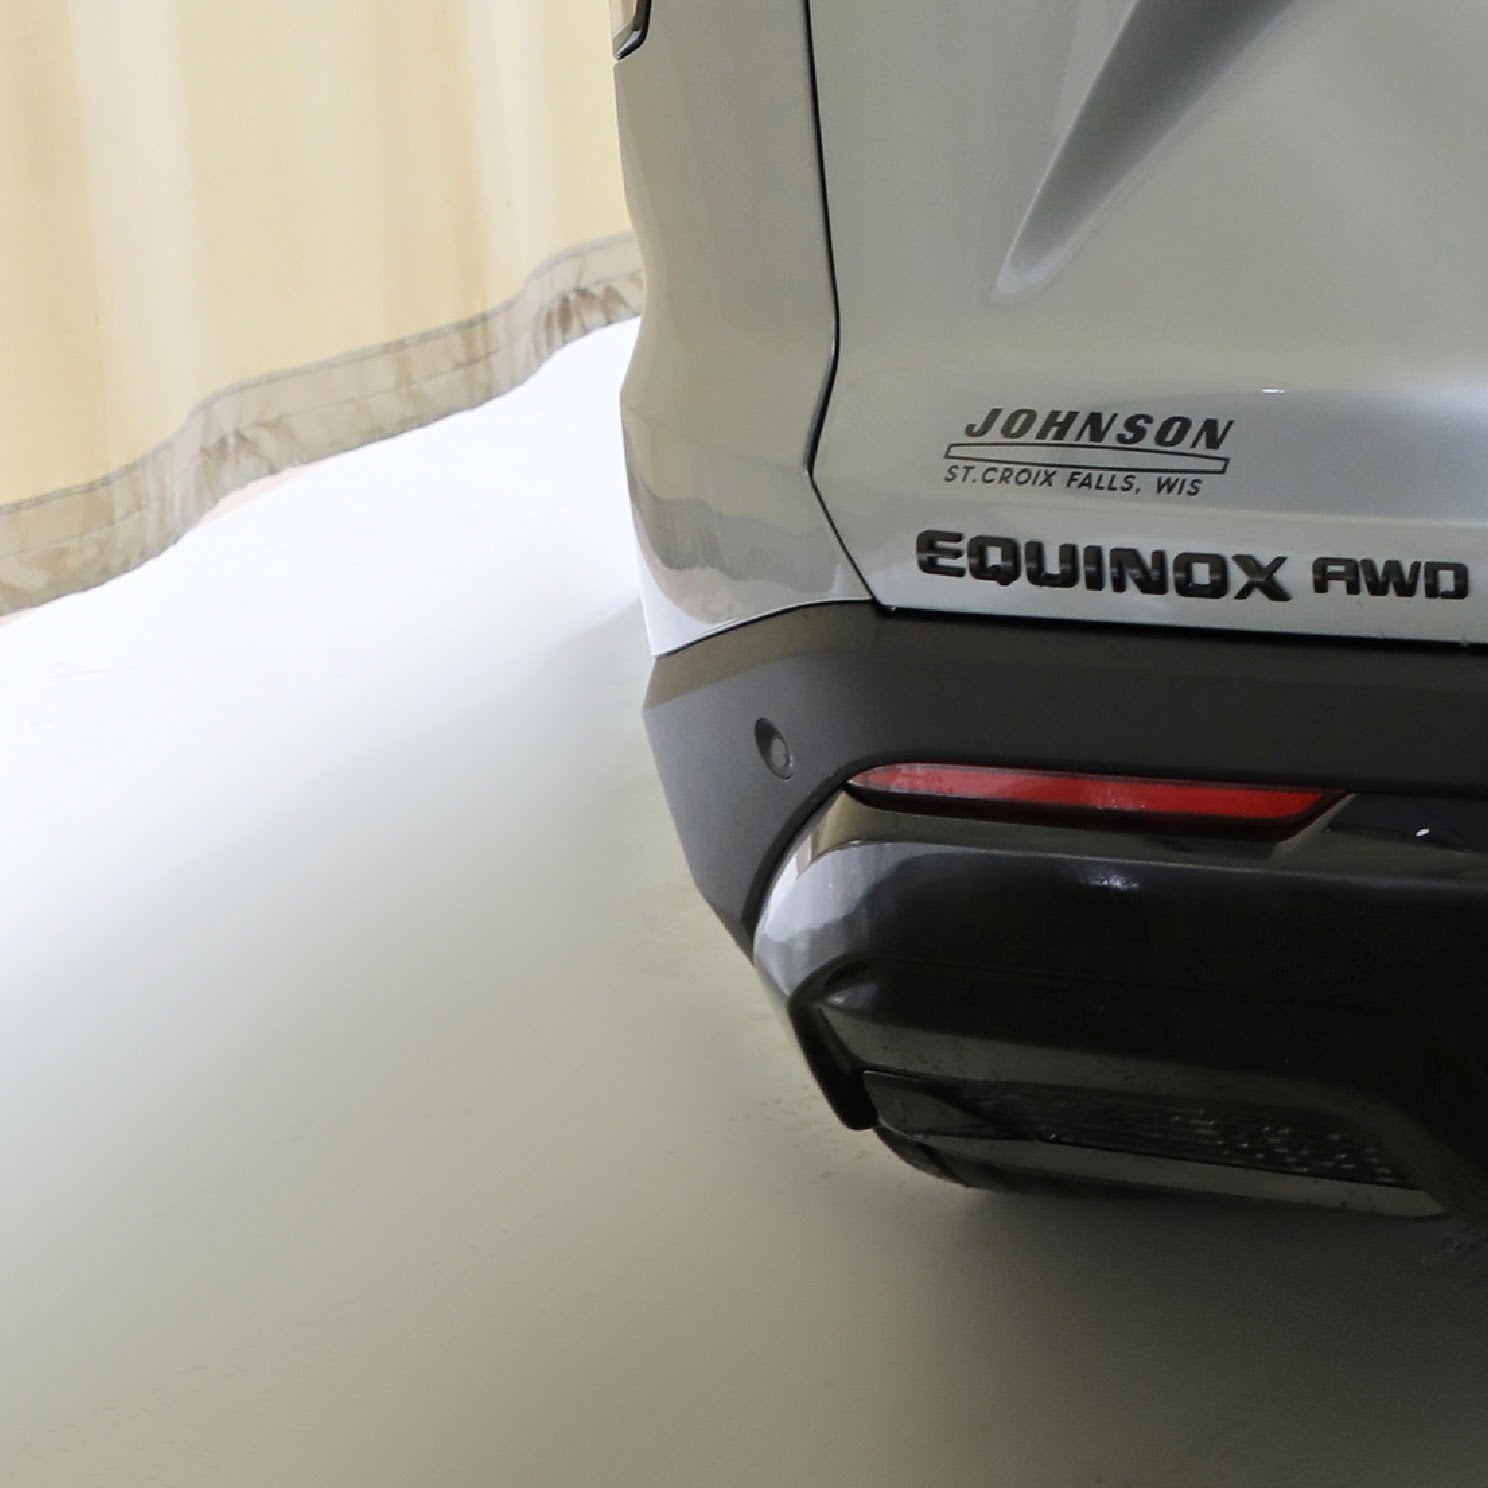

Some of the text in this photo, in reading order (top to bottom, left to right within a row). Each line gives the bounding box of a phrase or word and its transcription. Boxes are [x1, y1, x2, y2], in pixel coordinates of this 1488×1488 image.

[964, 406, 1235, 450] JOHNSON
[1066, 471, 1142, 495] FALLS,
[1155, 475, 1203, 497] WIS
[915, 528, 1472, 602] EQUINOX AWD
